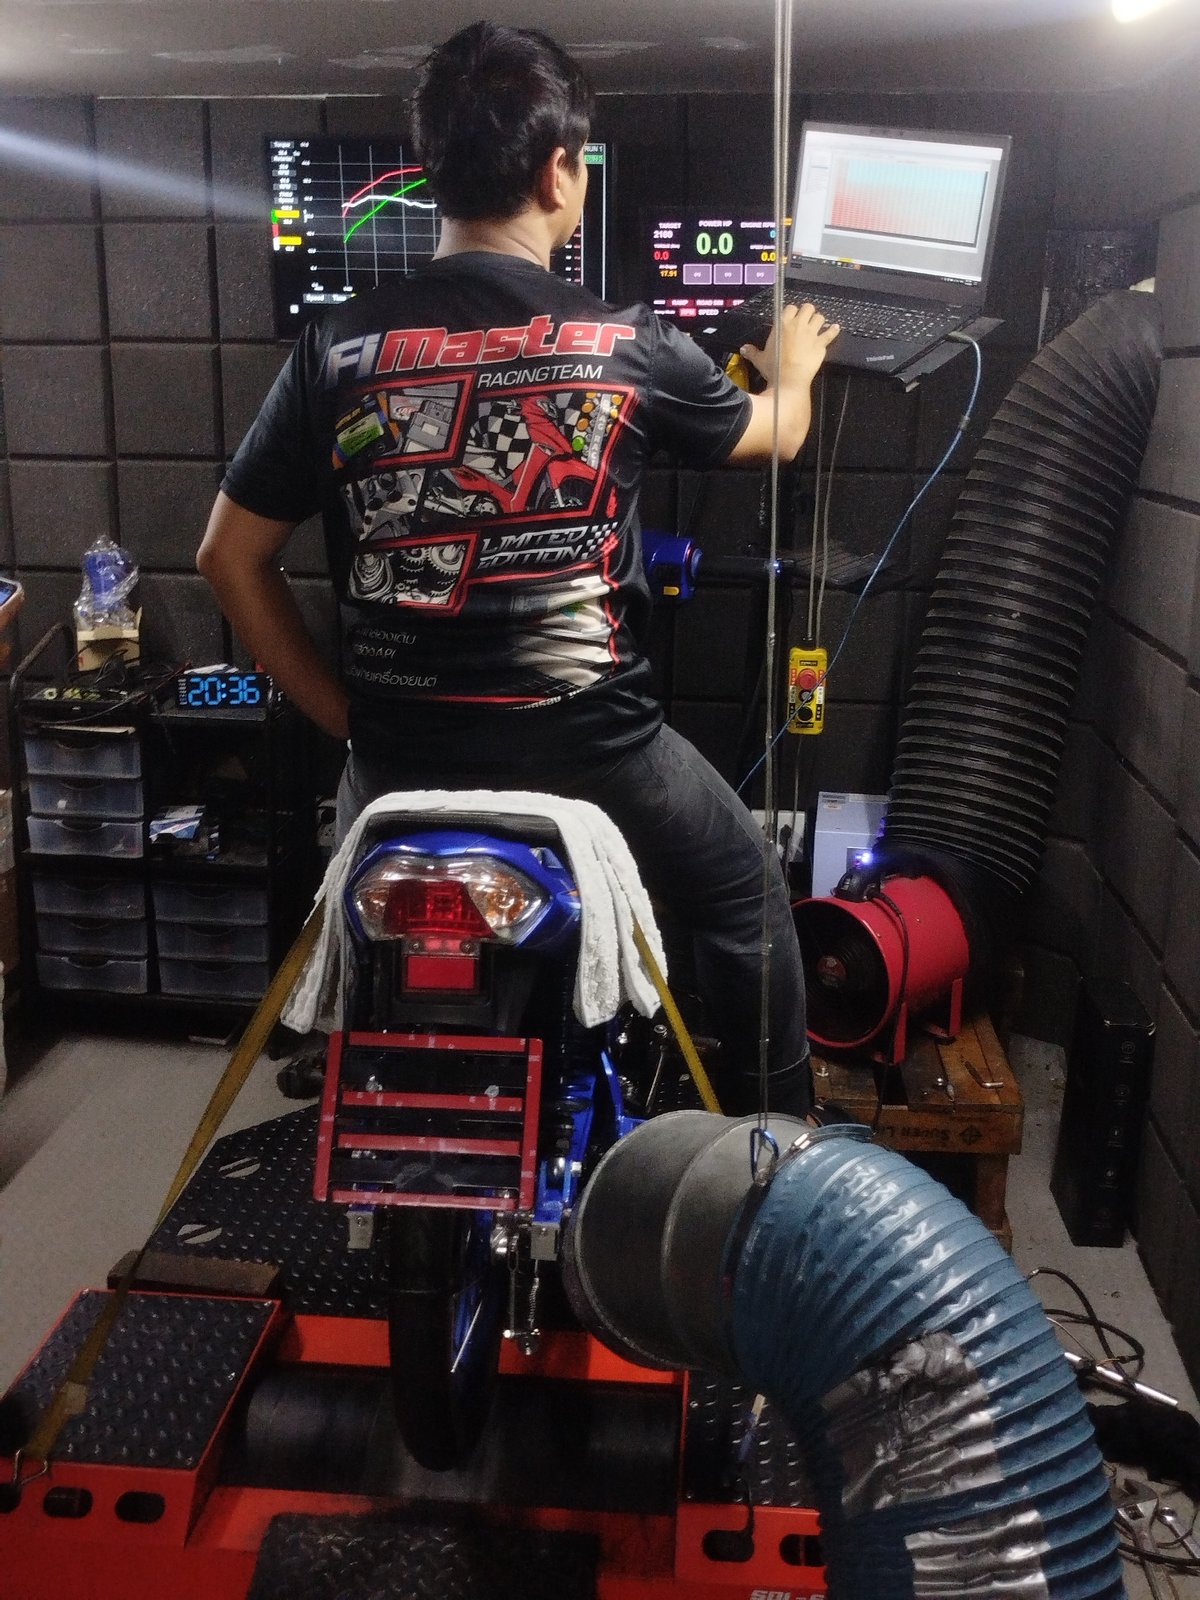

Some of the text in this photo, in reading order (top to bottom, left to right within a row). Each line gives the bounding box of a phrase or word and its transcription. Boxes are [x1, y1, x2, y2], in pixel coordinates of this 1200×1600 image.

[696, 232, 734, 255] 0.0
[653, 250, 670, 261] 0.0
[761, 251, 777, 262] 0.0
[481, 526, 589, 554] LIMITED
[187, 675, 260, 706] 20:36
